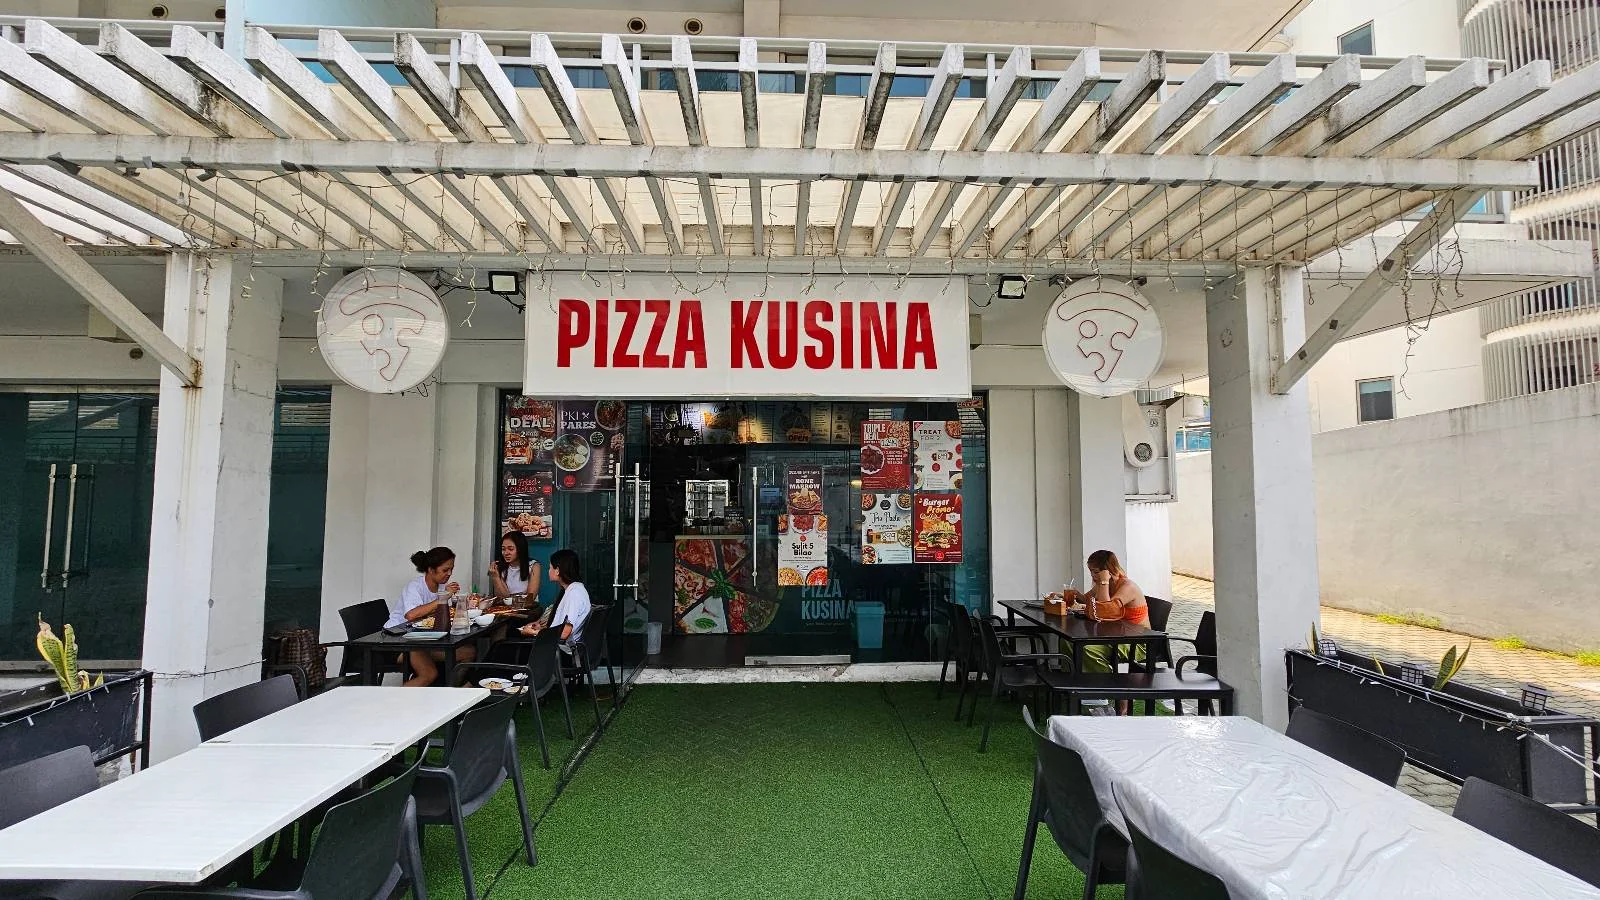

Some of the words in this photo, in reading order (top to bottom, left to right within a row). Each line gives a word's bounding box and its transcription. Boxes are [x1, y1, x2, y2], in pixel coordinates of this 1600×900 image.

[557, 299, 708, 368] PIZZA
[730, 300, 938, 370] KUSINA
[561, 411, 579, 420] PKI
[510, 418, 551, 428] DEAL
[560, 421, 597, 429] PARES
[863, 424, 886, 433] TRIPLE
[863, 432, 880, 440] DEAL
[922, 498, 950, 507] Burger
[792, 542, 808, 550] Sulit
[801, 579, 843, 598] PIZZA
[801, 600, 856, 620] KUSINA
